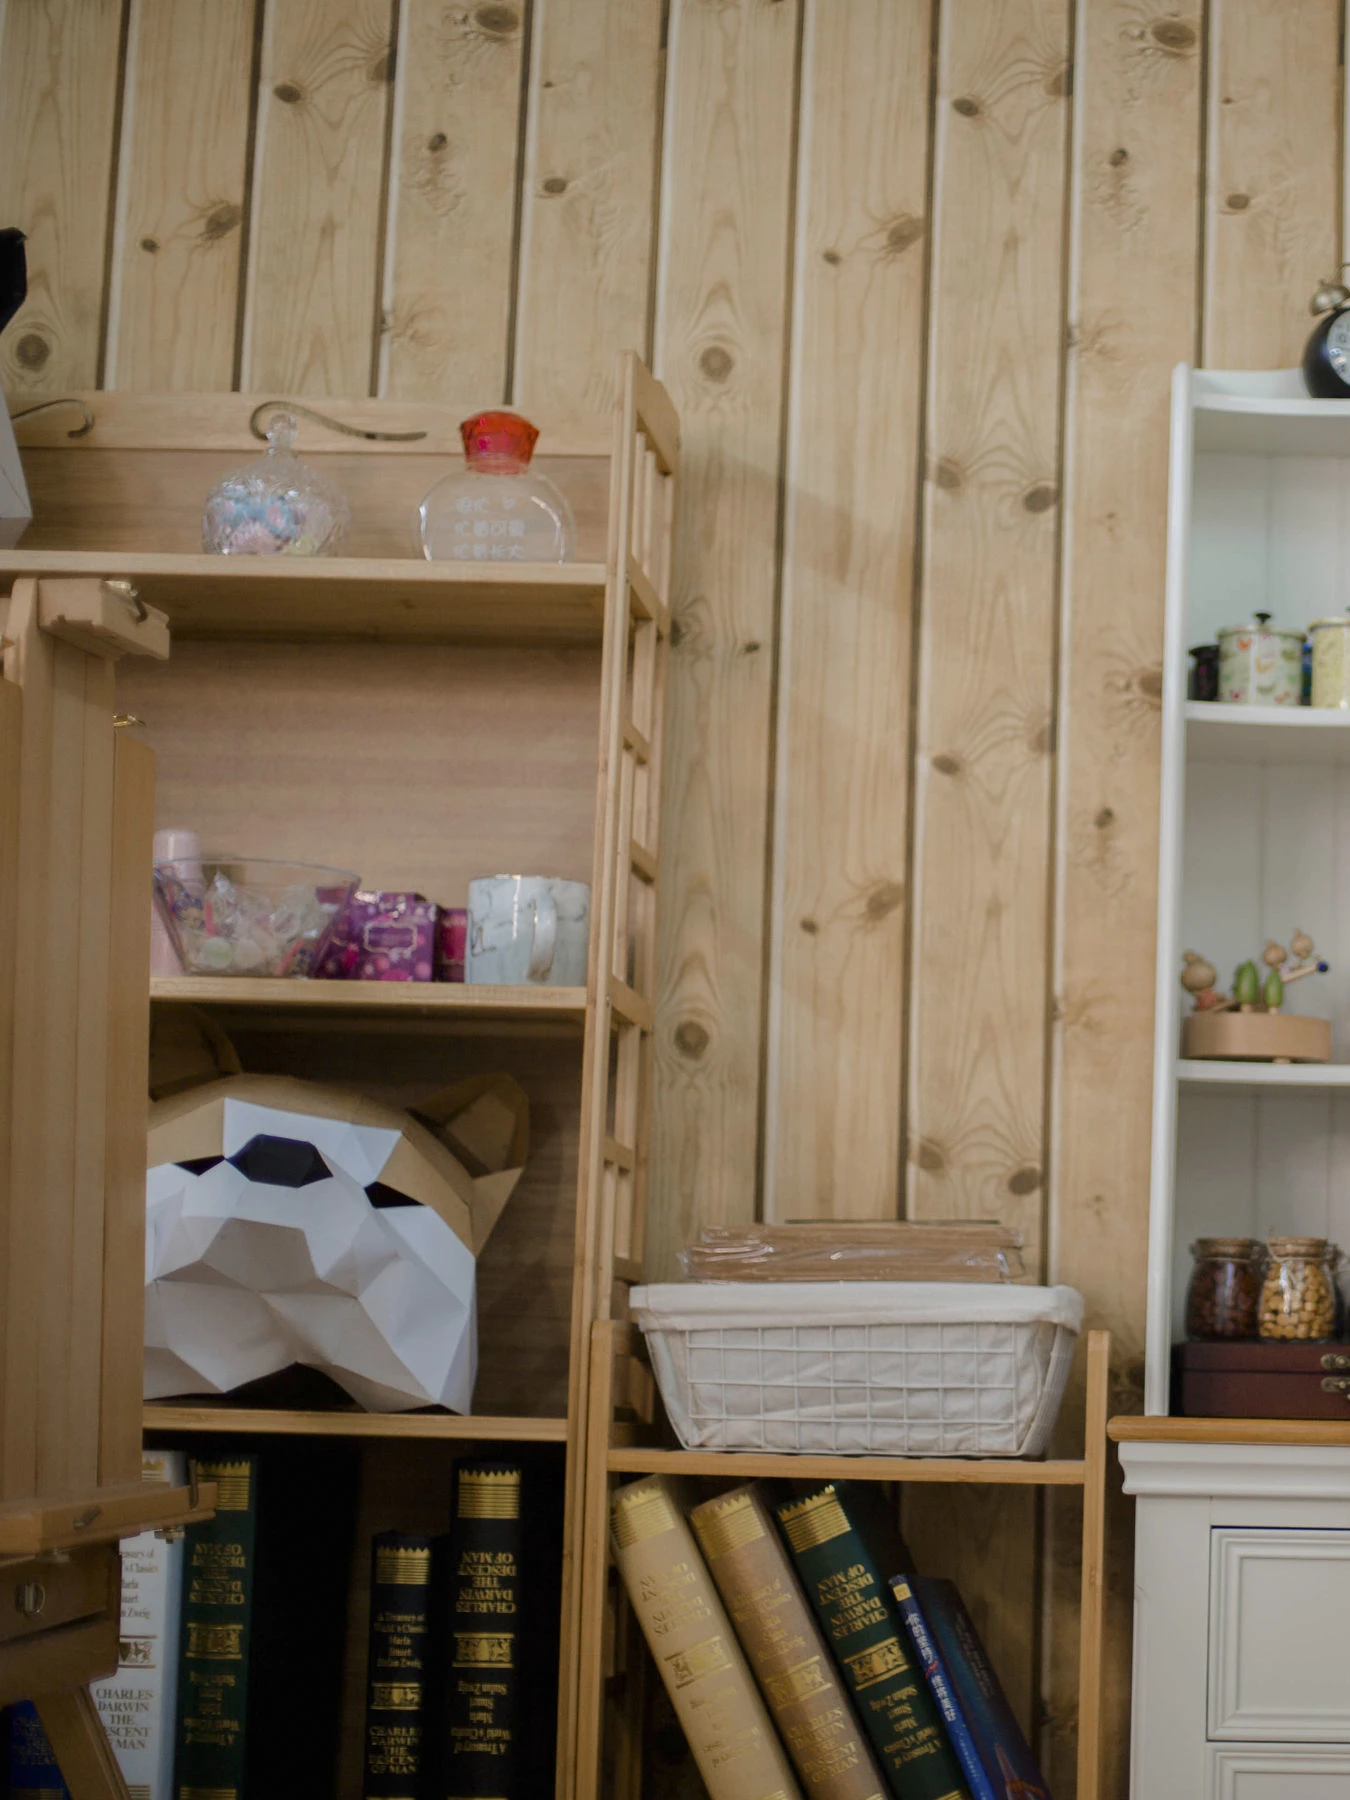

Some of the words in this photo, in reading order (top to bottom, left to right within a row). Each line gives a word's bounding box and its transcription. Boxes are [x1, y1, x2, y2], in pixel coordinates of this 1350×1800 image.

[462, 1551, 494, 1564] MAN
[495, 1552, 514, 1564] OF
[457, 1564, 517, 1576] DESCENT
[847, 1564, 866, 1579] OF
[472, 1577, 500, 1588] THE
[816, 1572, 848, 1591] MAN
[458, 1588, 513, 1601] DARWIN
[819, 1573, 874, 1606] DESCENT
[456, 1601, 517, 1613] CHARLES
[838, 1592, 864, 1611] THE
[829, 1596, 882, 1626] DARWIN
[832, 1608, 888, 1640] CHARLES
[96, 1688, 153, 1700] CHARLES
[98, 1701, 149, 1712] DARWIN
[109, 1714, 135, 1725] THE
[115, 1738, 146, 1750] MAN
